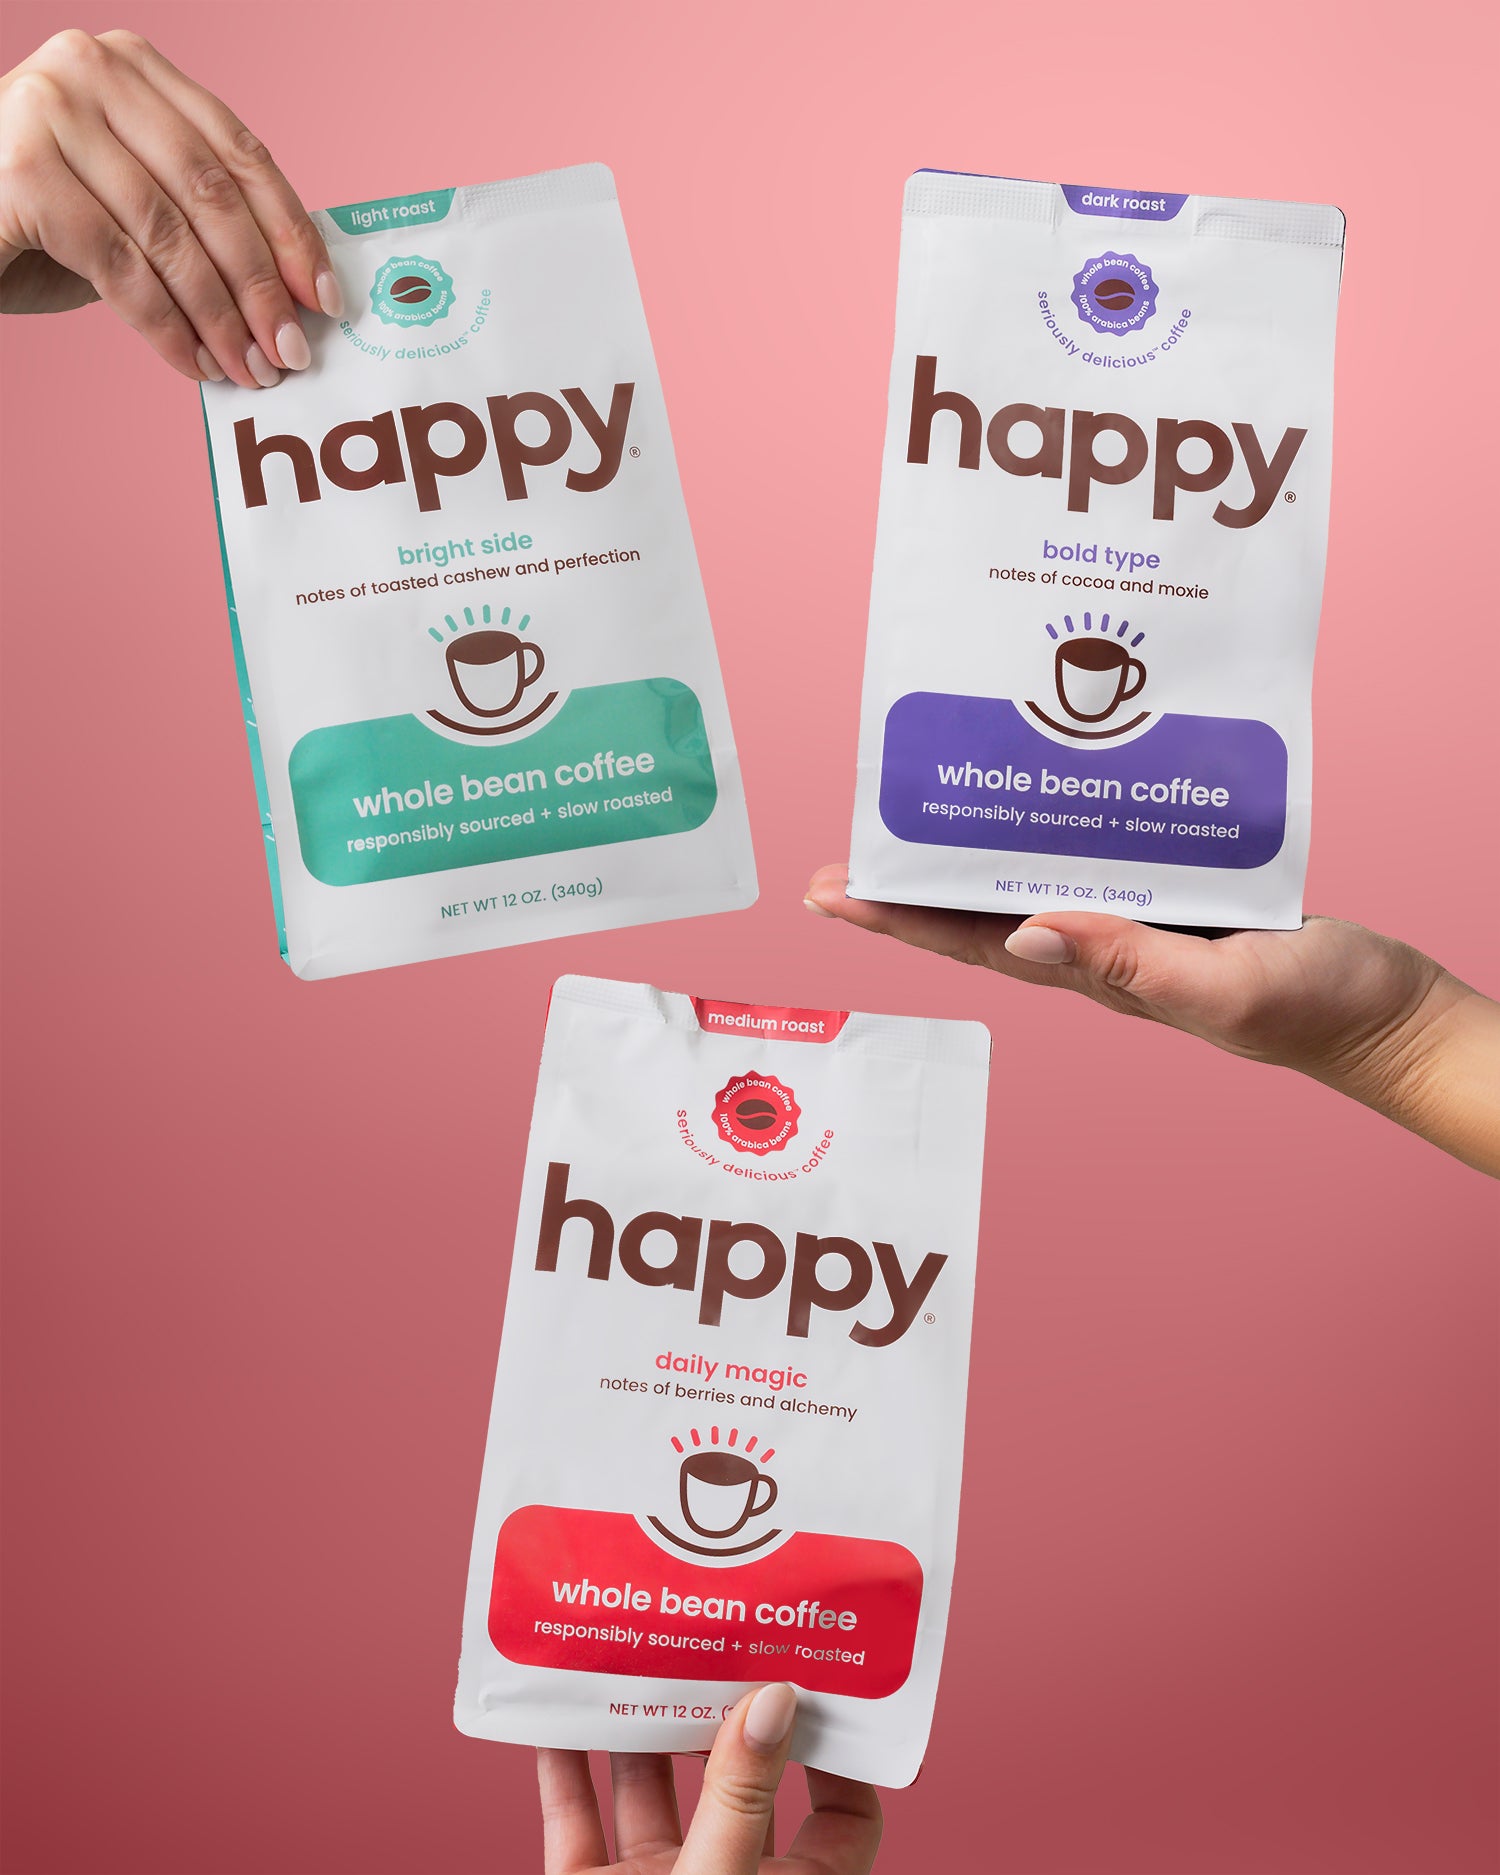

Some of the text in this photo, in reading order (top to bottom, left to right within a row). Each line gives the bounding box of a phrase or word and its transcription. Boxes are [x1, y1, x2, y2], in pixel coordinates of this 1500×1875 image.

[351, 199, 436, 229] light roast
[1081, 192, 1166, 212] dark roast
[377, 260, 443, 295] whole bean coffee
[1081, 259, 1150, 291] whole bean coffee
[378, 290, 447, 321] 100% arabica beans
[1038, 291, 1080, 356] seriously
[1161, 309, 1191, 351] coffee
[1079, 294, 1150, 329] 100% arabica beans
[340, 321, 391, 361] seriously
[470, 288, 491, 333] coffee
[397, 531, 533, 568] bright side
[1042, 539, 1161, 573] bold type
[296, 547, 641, 605] notes of toasted cashew and perfection
[989, 566, 1209, 599] notes of cocoa and moxie
[353, 751, 656, 818] whole bean coffee
[937, 762, 1230, 807] whole bean coffee
[347, 787, 673, 854] responsibly sourced + slow roasted
[922, 801, 1240, 839] responsibly sourced + slow roasted
[440, 878, 603, 919] NET WT 12 OZ. (340g)
[996, 879, 1153, 907] NET WT 12 OZ. (340g)
[708, 1010, 825, 1035] medium roast
[722, 1078, 792, 1111] whole bean coffee
[677, 1109, 720, 1166] seriously
[802, 1129, 834, 1173] coffee
[720, 1113, 792, 1149] 100% arabica beans
[655, 1351, 808, 1391] daily magic
[600, 1375, 858, 1422] notes of berries and alchemy
[552, 1579, 858, 1632] whole bean coffee
[534, 1618, 865, 1666] responsibly sourced + slow roasted
[609, 1703, 638, 1715] NET
[643, 1705, 668, 1717] WT
[673, 1705, 687, 1718] 12
[691, 1706, 716, 1719] OZ.
